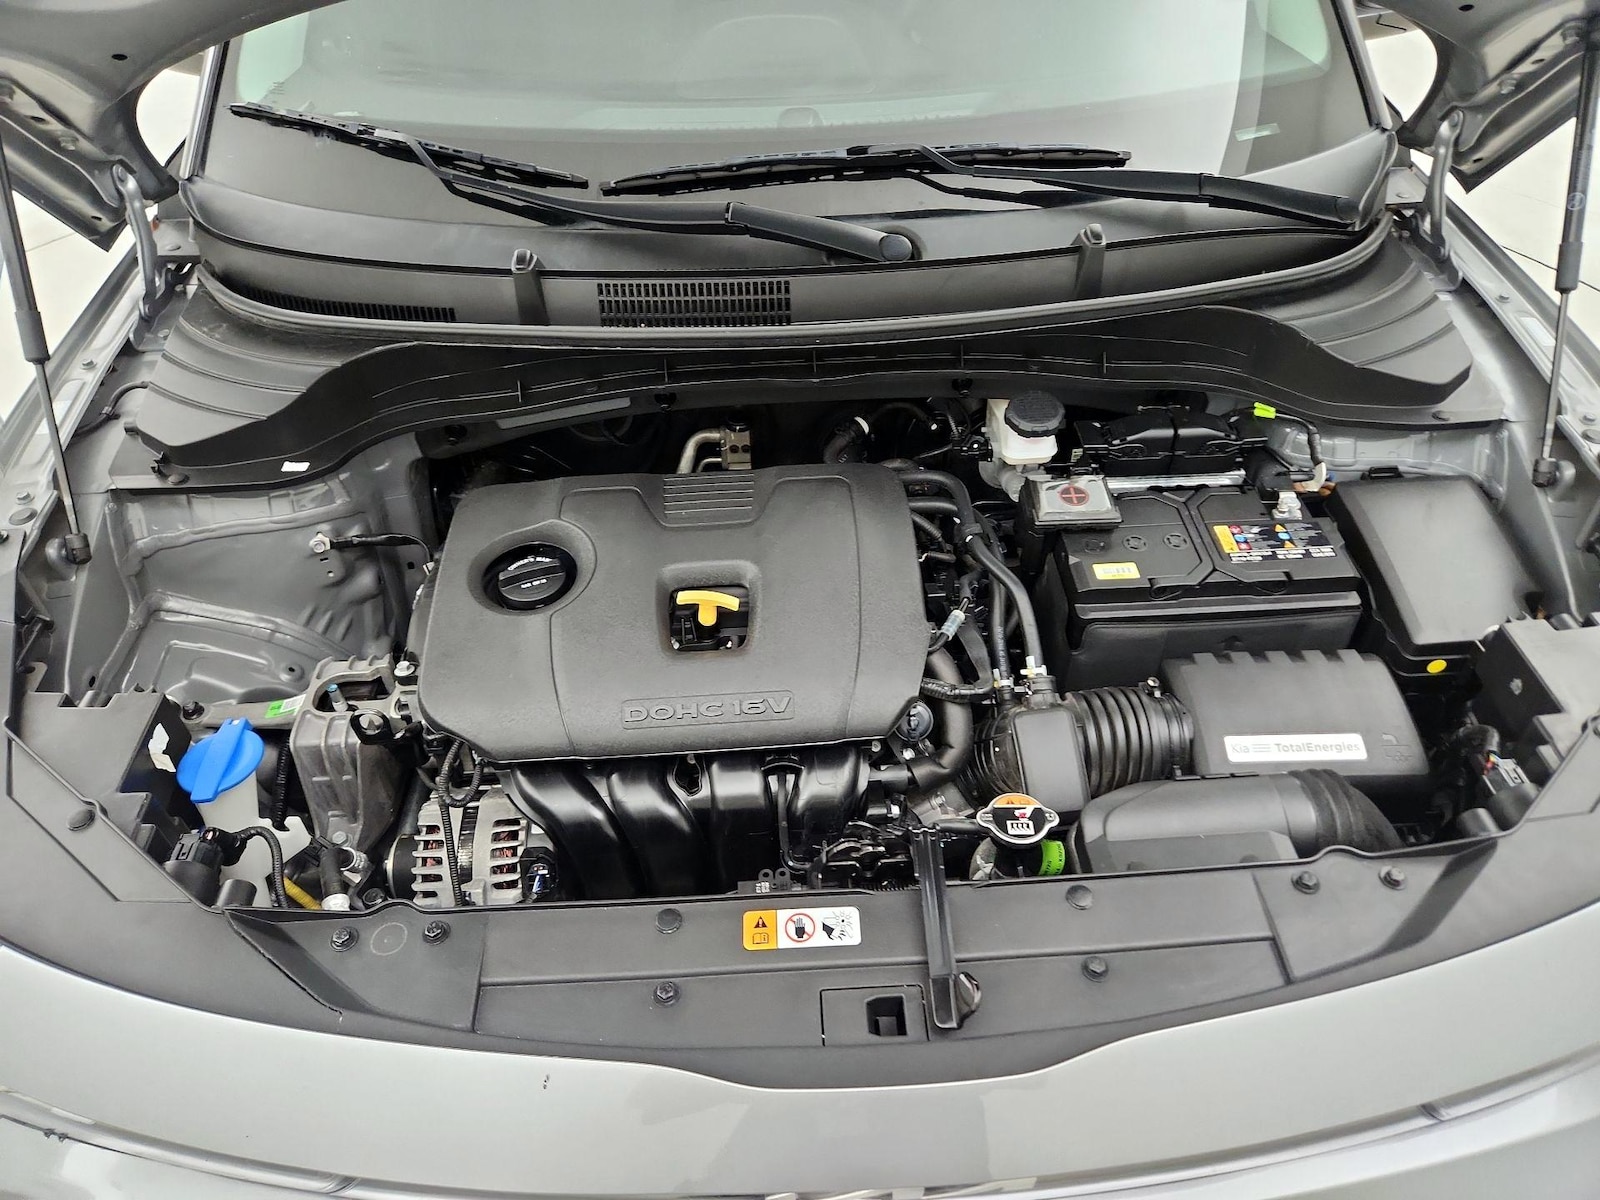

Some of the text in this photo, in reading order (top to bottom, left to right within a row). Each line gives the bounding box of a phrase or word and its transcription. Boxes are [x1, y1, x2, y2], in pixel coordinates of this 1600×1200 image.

[624, 696, 792, 723] DOHC 16V
[1230, 741, 1361, 754] Kia TotalEnergies
